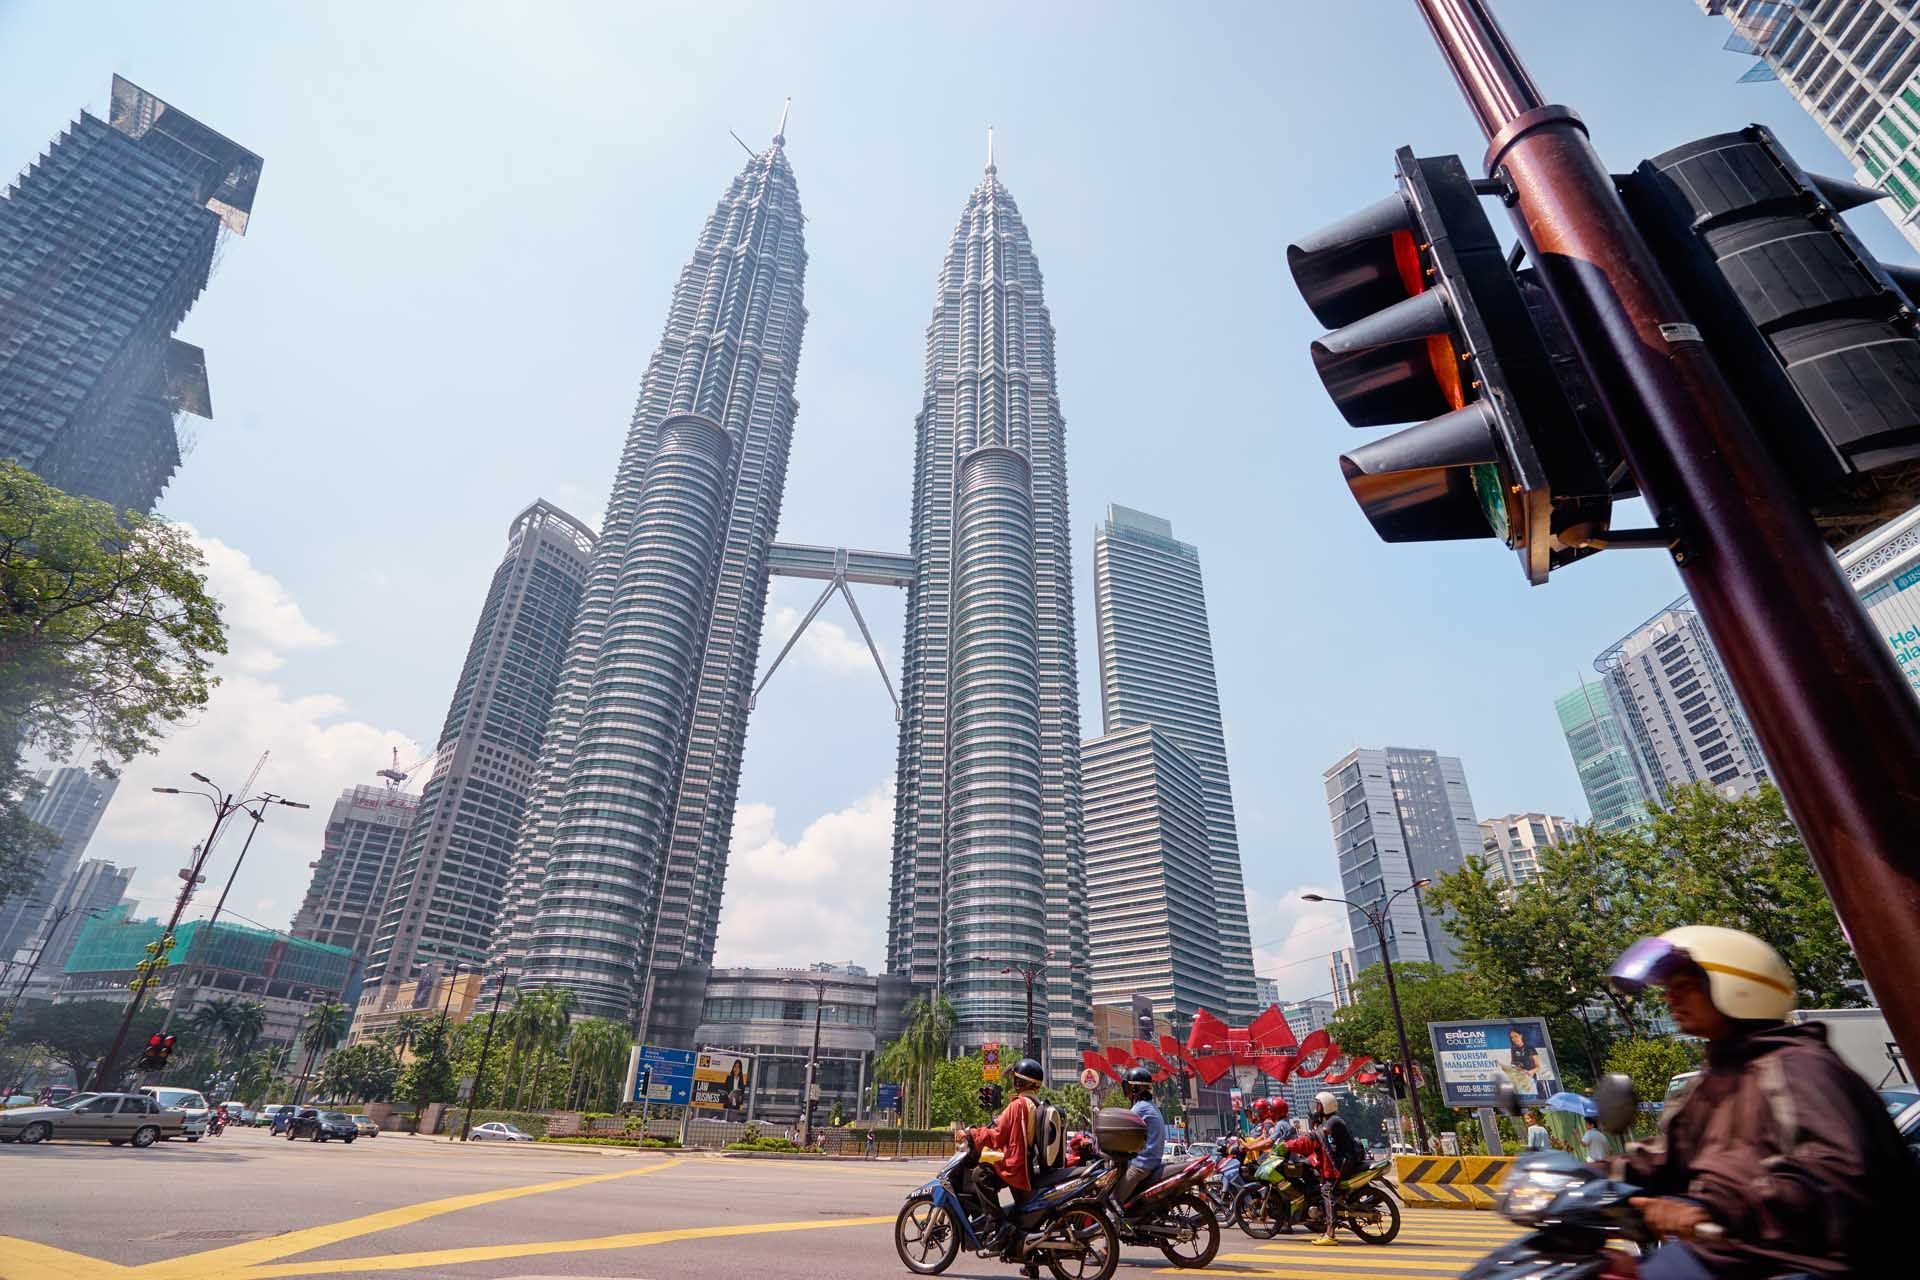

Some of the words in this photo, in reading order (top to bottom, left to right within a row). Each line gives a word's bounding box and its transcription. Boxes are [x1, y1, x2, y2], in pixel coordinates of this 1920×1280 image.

[1446, 1038, 1488, 1046] COLLEGE
[1452, 1052, 1488, 1060] TOURISM
[1445, 1060, 1498, 1069] MANAGEMENT
[697, 1081, 709, 1092] LAW
[695, 1091, 720, 1103] BUSINESS
